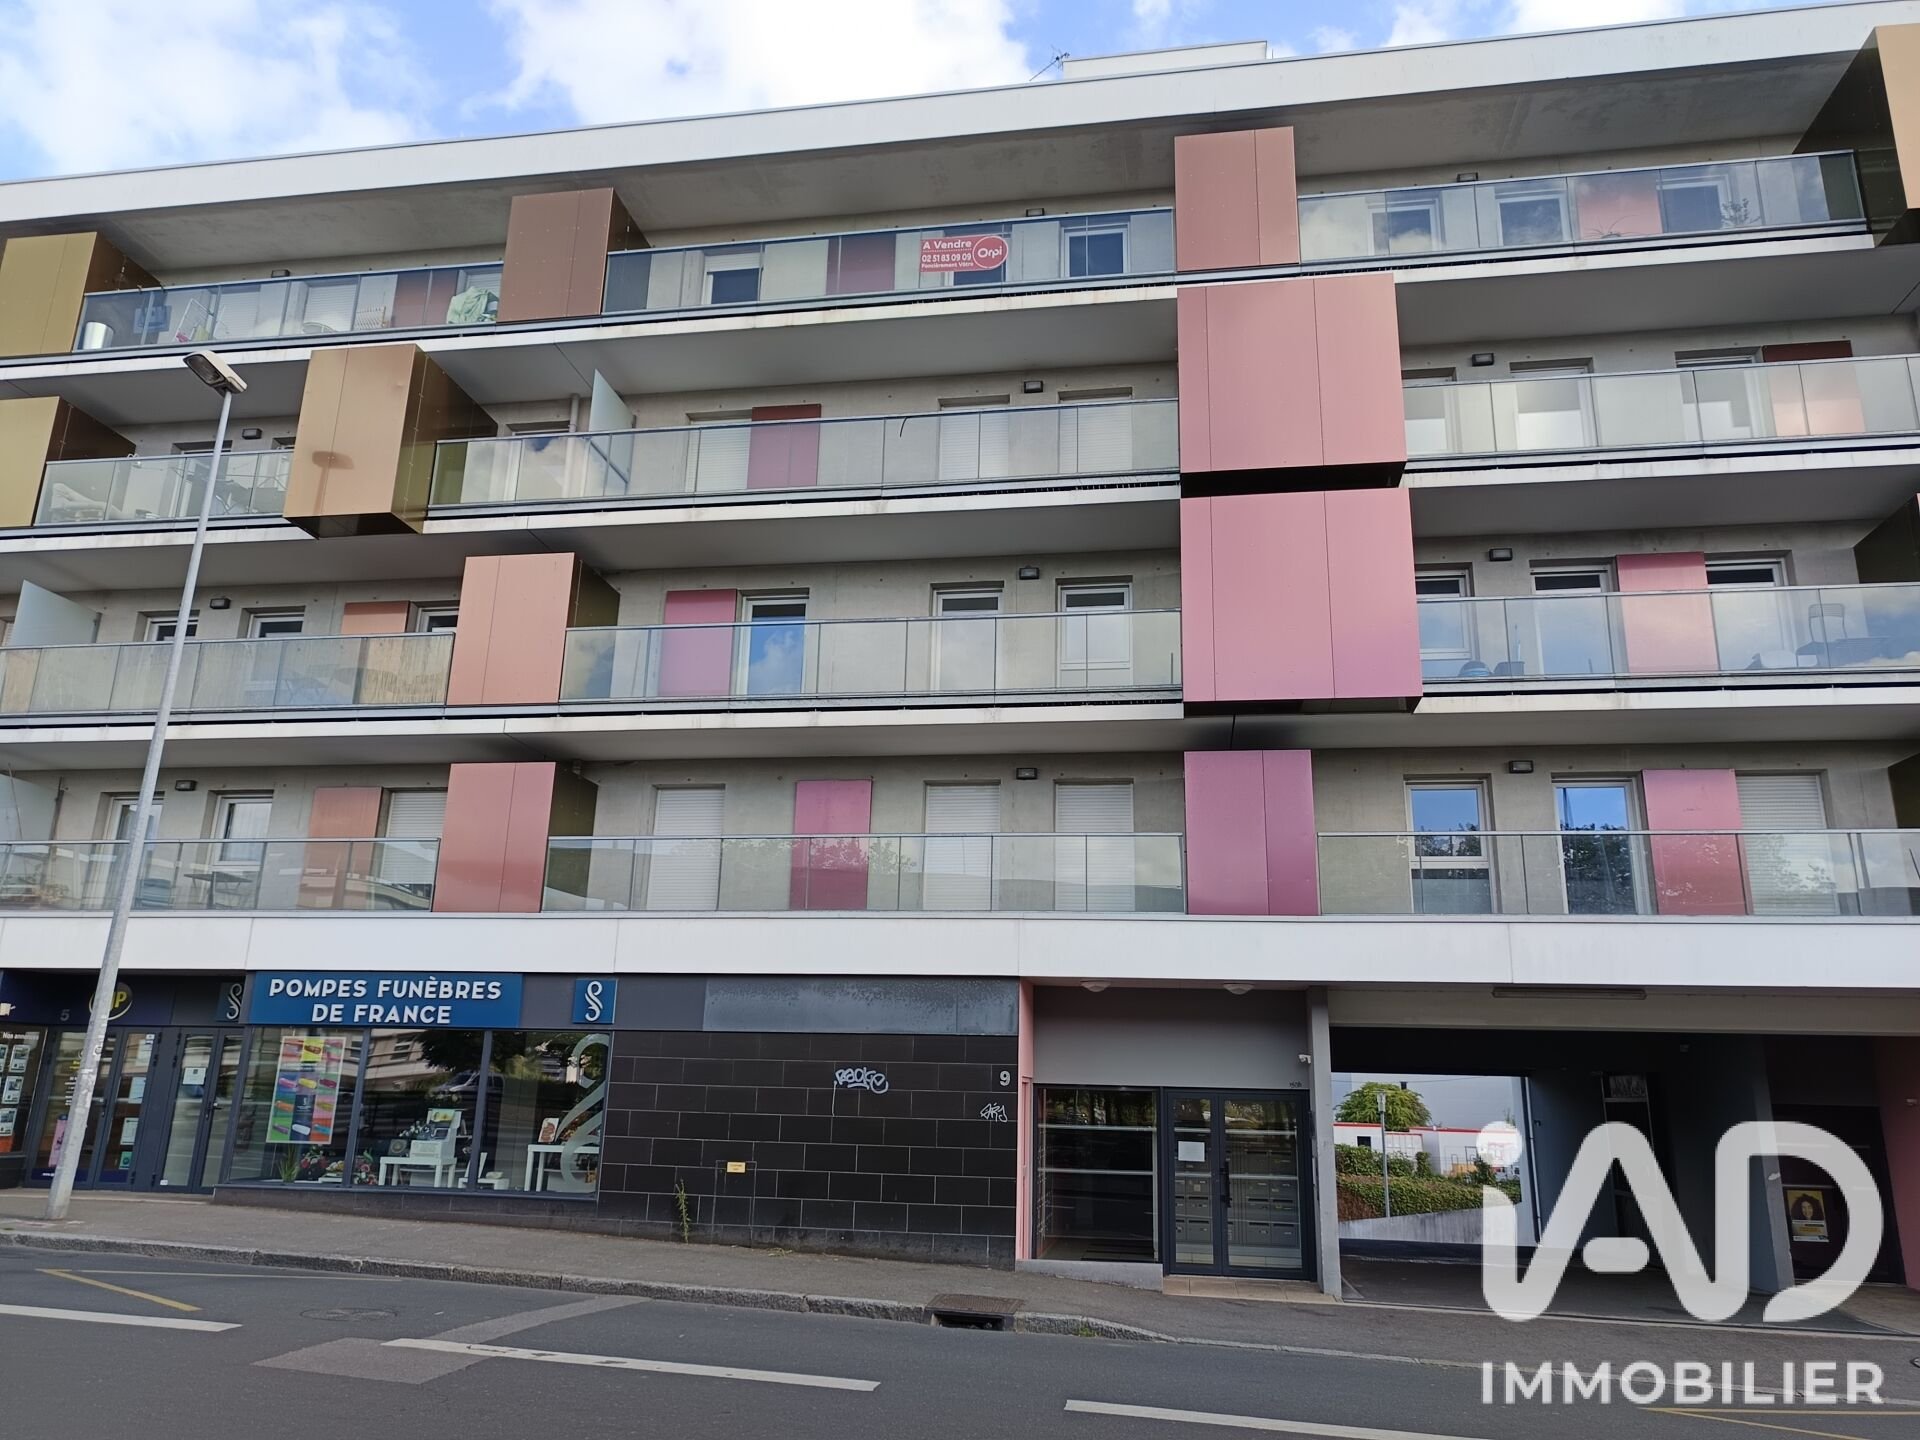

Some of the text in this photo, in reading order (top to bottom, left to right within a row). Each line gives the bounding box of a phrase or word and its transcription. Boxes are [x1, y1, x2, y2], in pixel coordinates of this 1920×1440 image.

[923, 240, 972, 250] A Vendre
[921, 254, 932, 262] 02
[933, 254, 941, 262] 51
[951, 253, 961, 262] 09
[962, 253, 972, 261] 09
[977, 246, 1003, 259] Orpi
[269, 975, 502, 1000] POMPES FUNÈBRES
[60, 1009, 70, 1021] 5
[311, 1003, 452, 1024] DE FRANCE
[1000, 1071, 1011, 1086] 9
